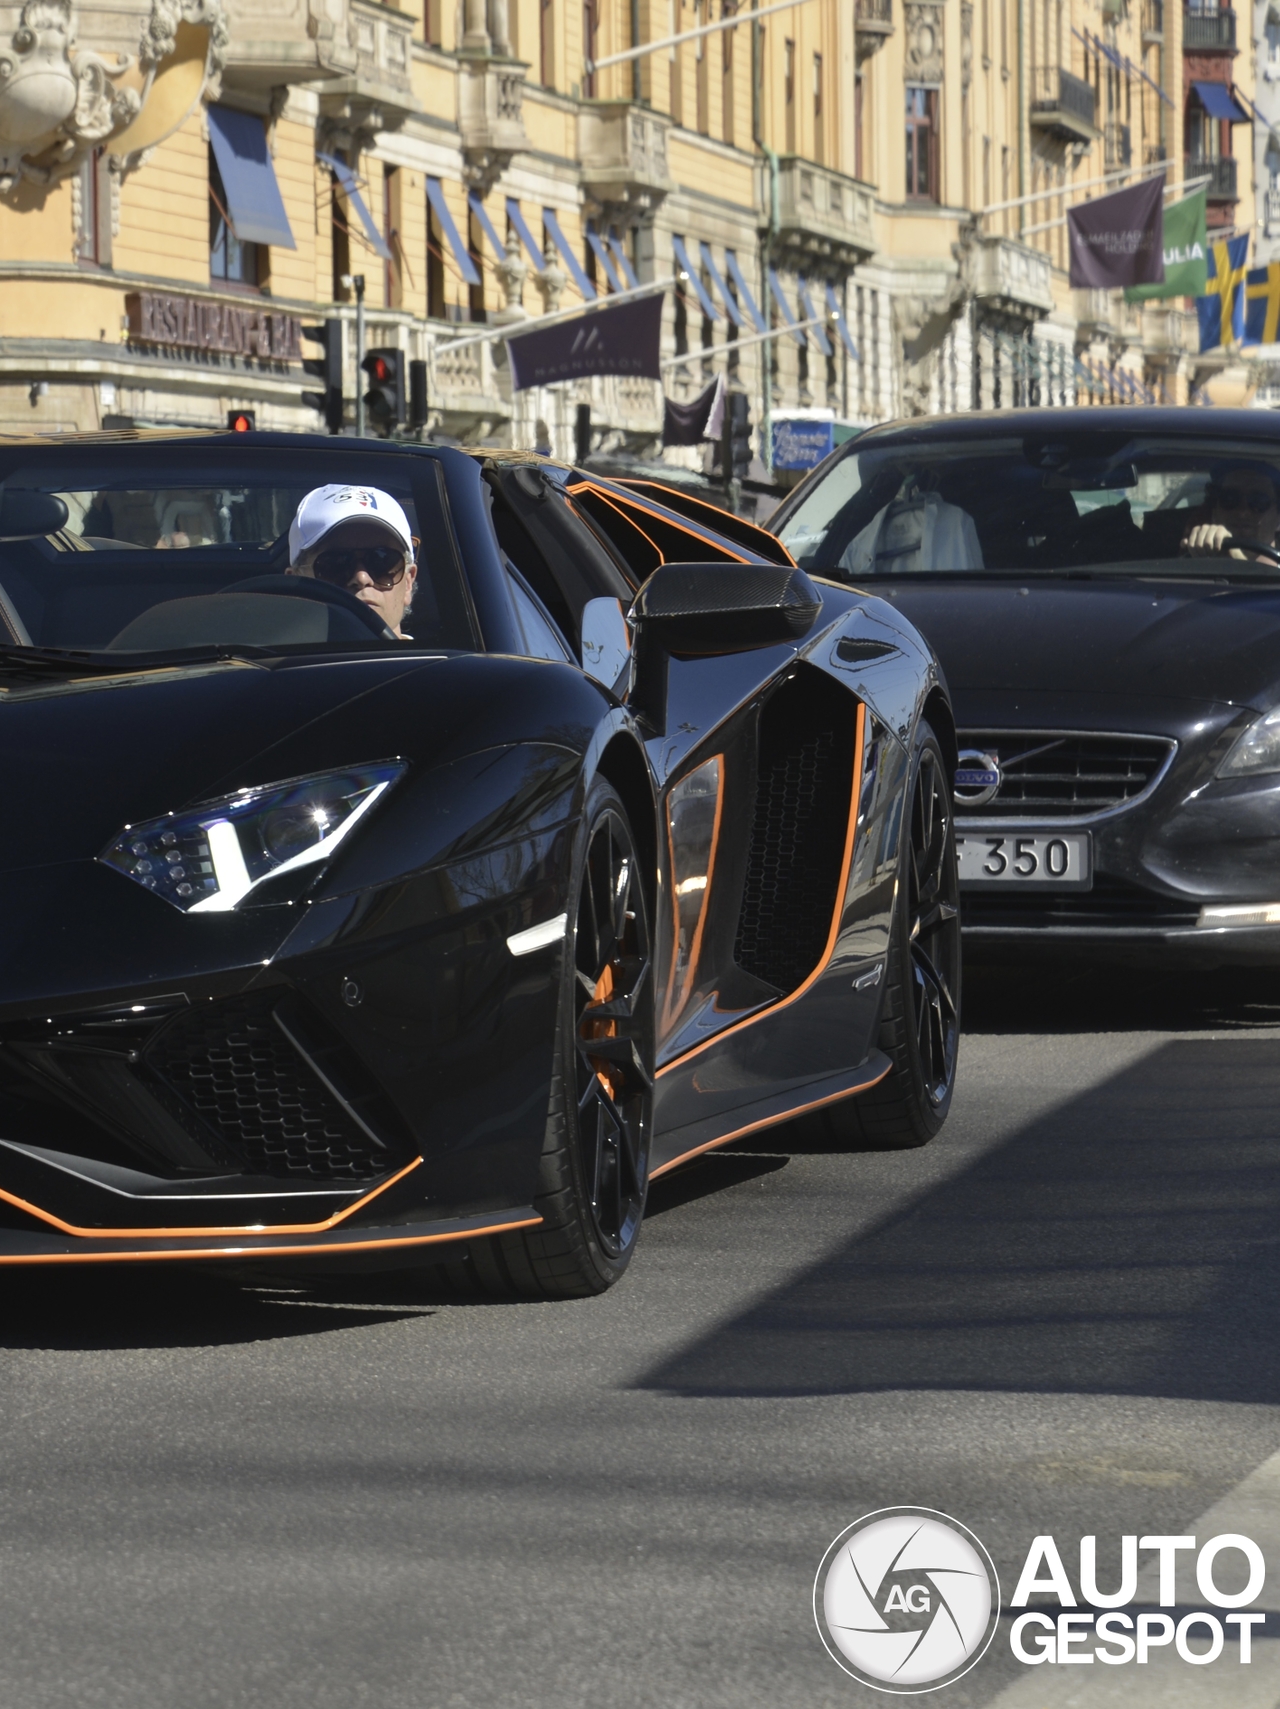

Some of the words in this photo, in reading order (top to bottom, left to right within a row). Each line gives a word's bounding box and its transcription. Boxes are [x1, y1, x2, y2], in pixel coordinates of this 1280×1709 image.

[1105, 240, 1154, 254] HOLDNG
[534, 358, 643, 378] MAGNUSSON
[955, 773, 995, 783] OLVO
[983, 838, 1071, 877] 350
